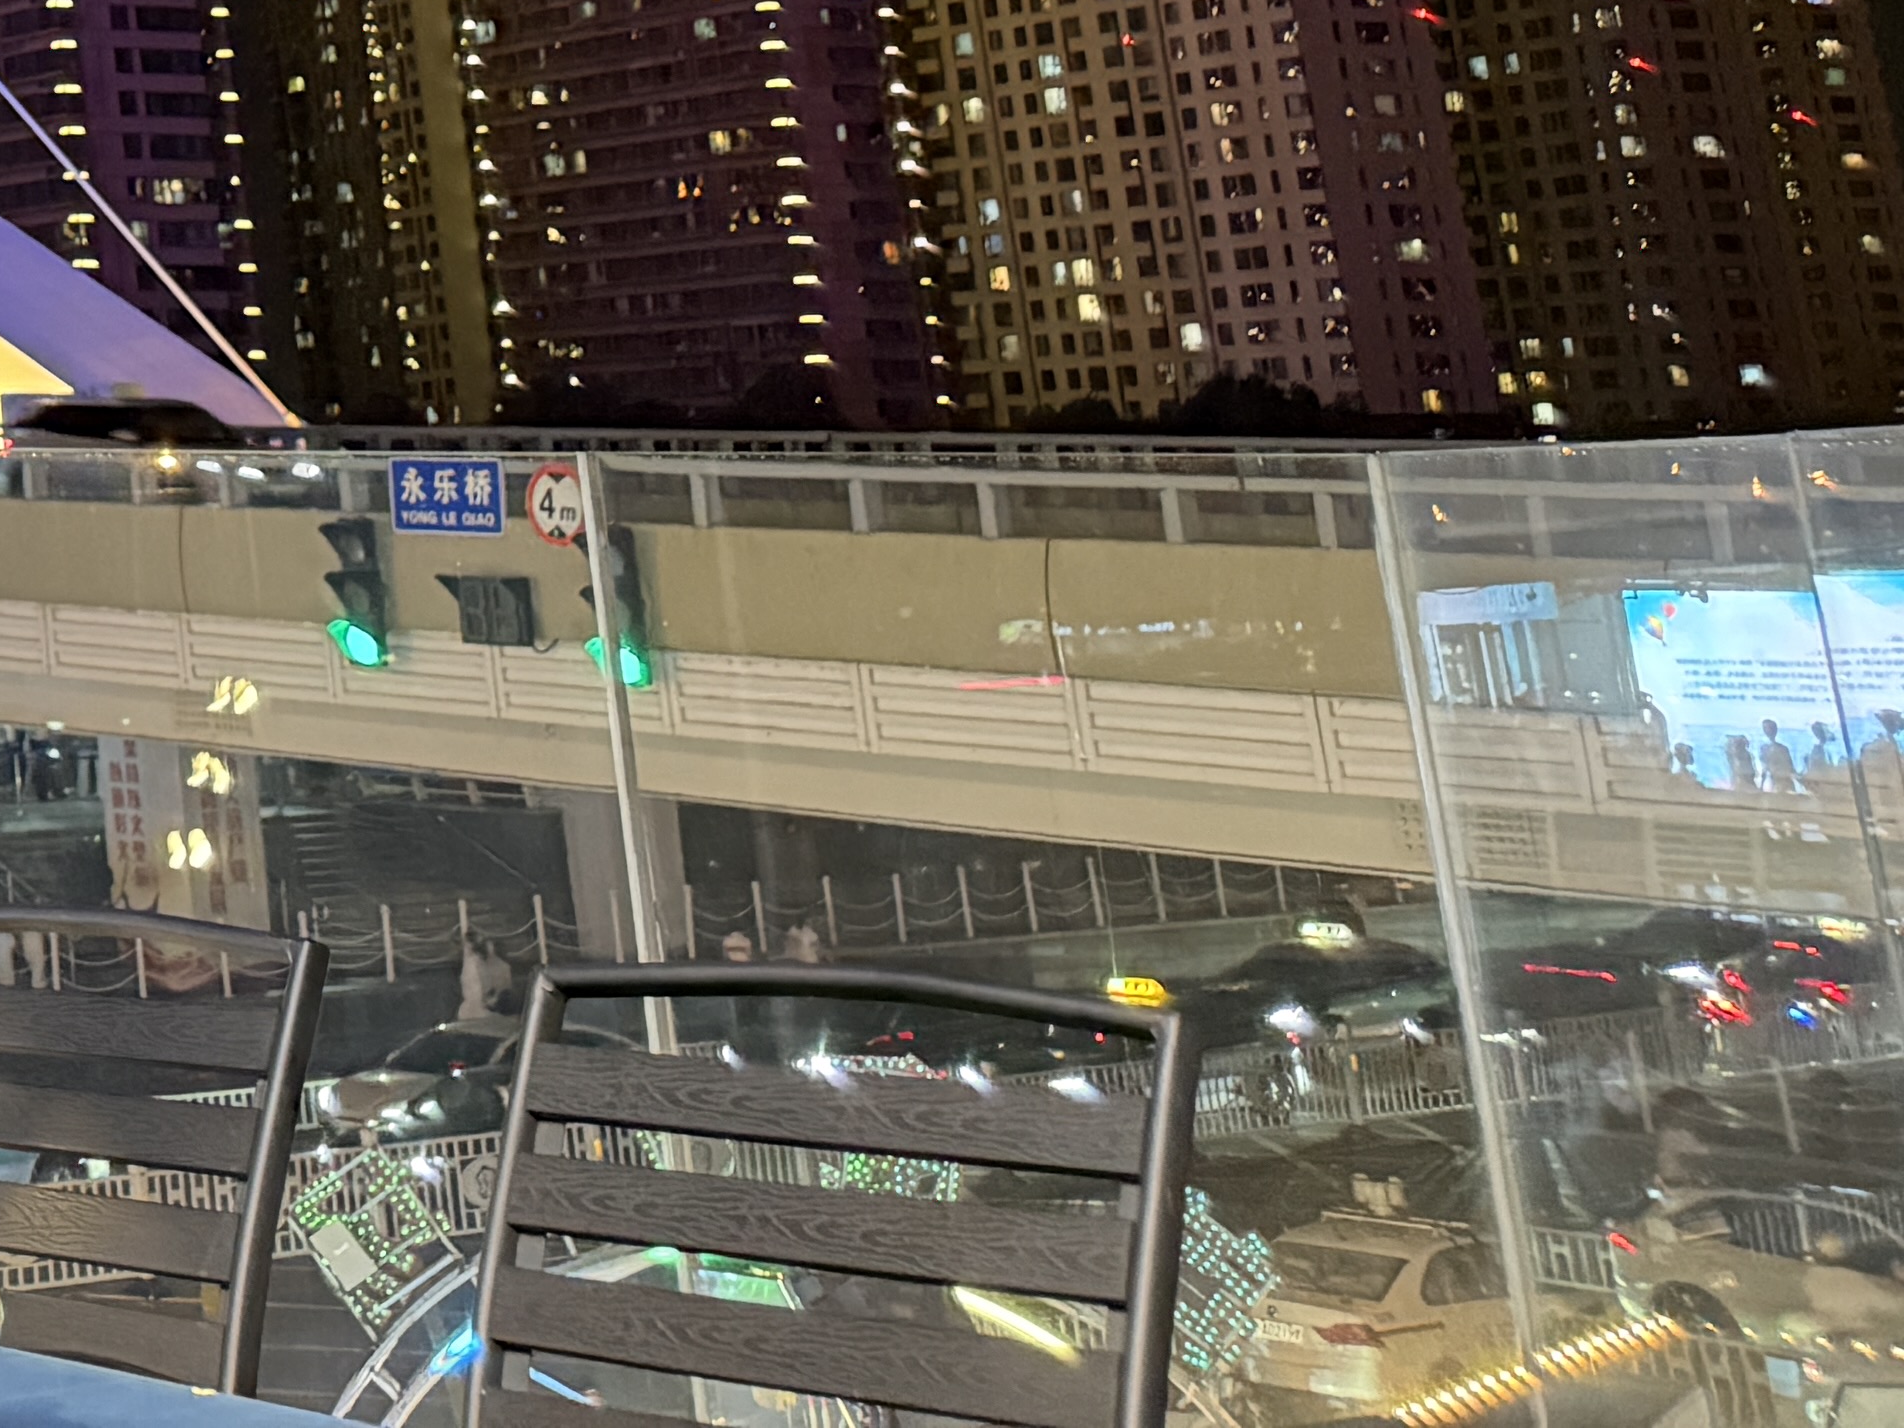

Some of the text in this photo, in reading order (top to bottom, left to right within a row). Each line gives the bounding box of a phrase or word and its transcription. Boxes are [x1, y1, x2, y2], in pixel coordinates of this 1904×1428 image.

[400, 466, 493, 507] 永乐桥
[401, 510, 496, 528] YONG LE QIAO
